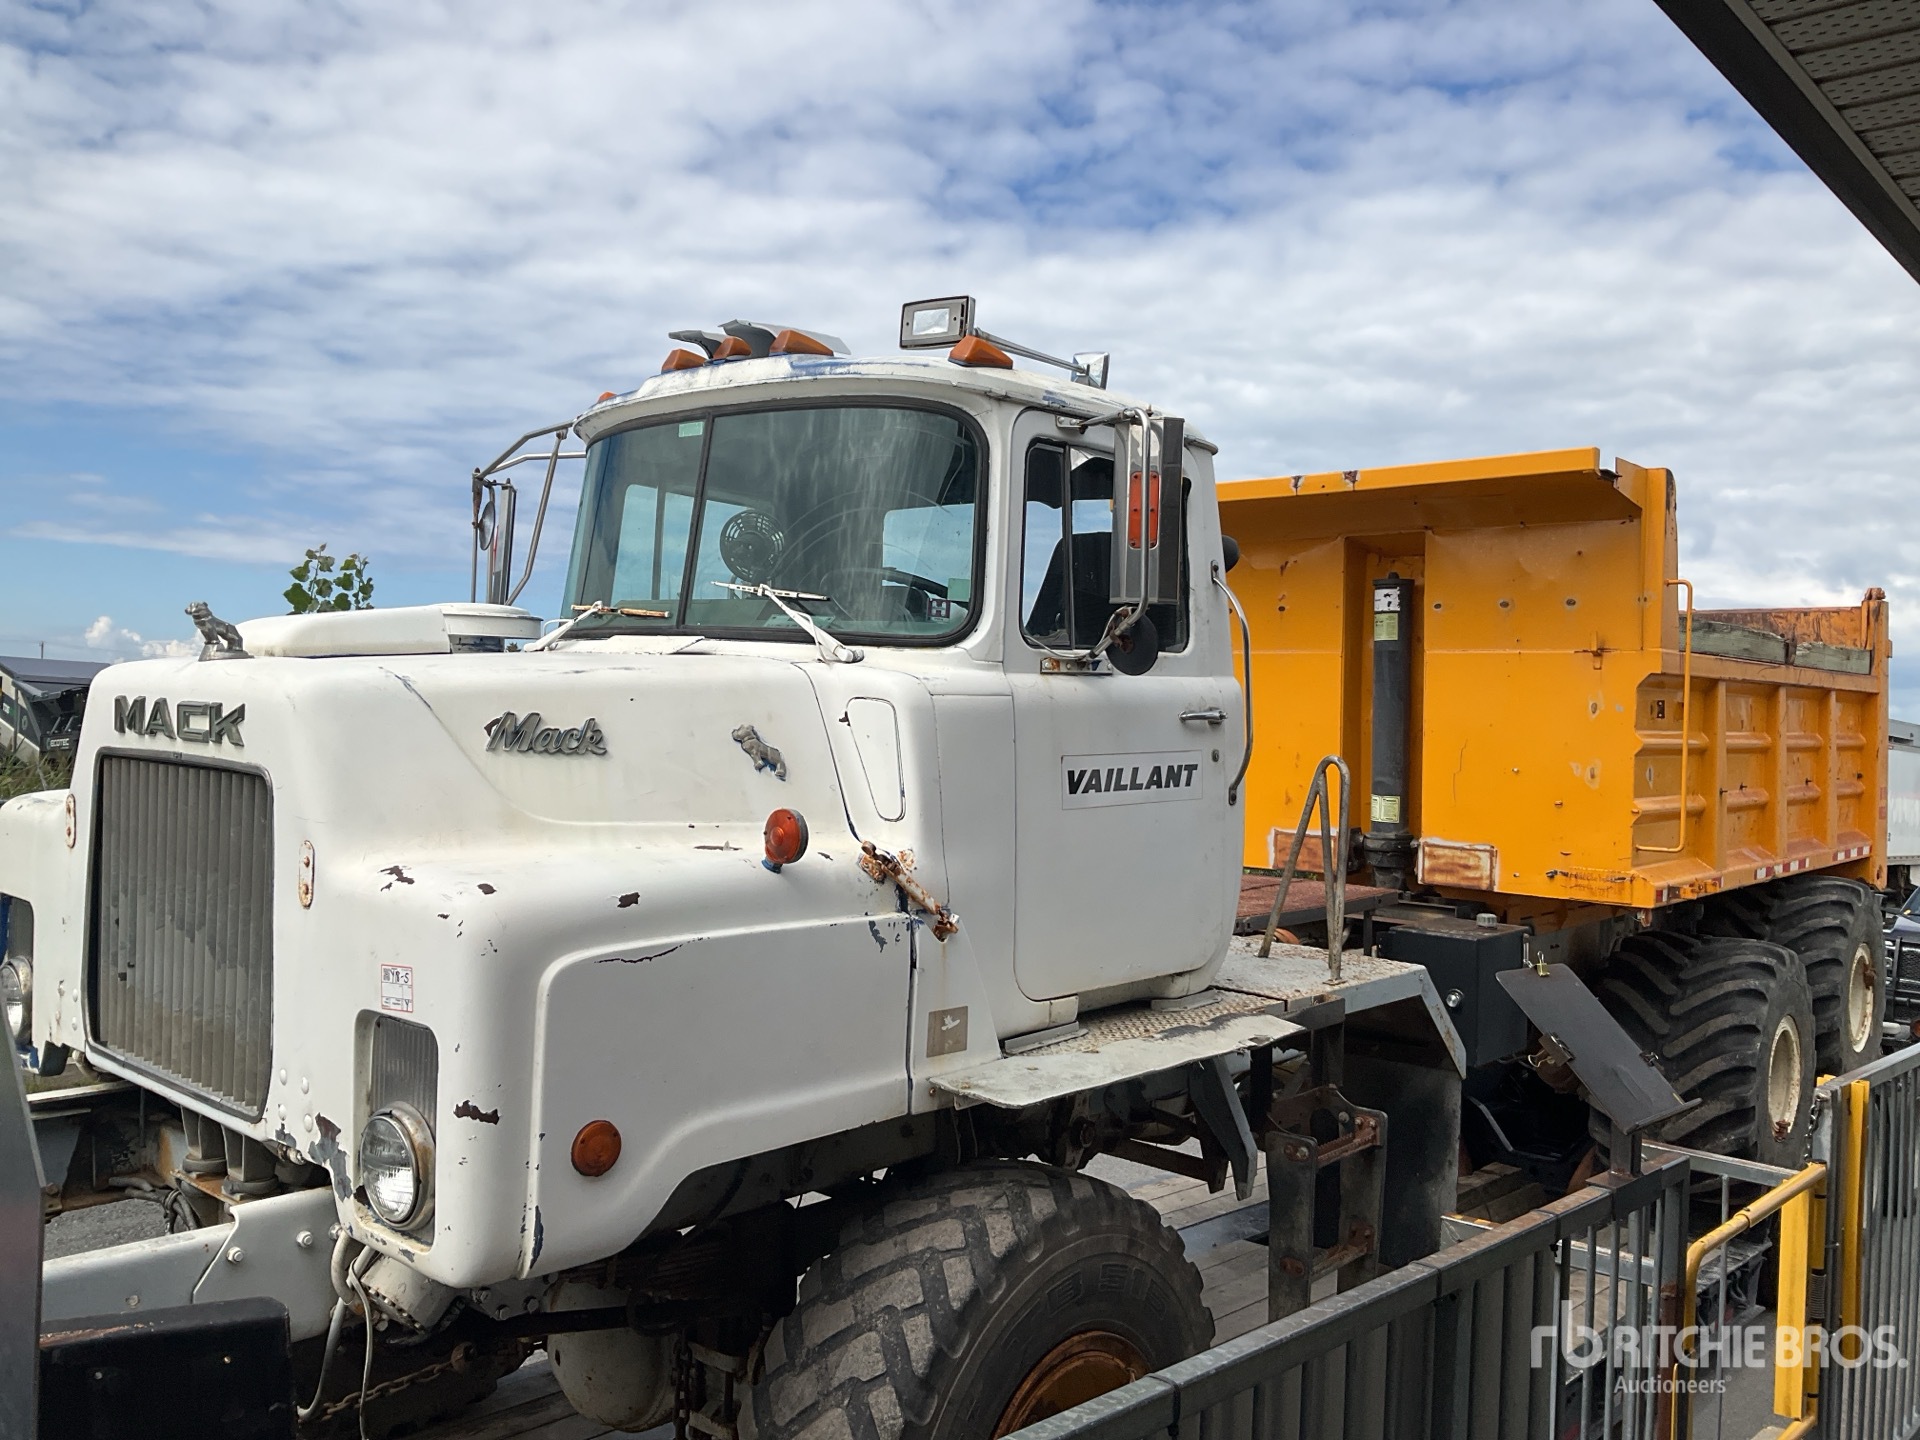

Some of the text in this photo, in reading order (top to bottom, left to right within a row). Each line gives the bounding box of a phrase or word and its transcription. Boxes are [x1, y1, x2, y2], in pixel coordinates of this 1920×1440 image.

[114, 695, 246, 747] MACK
[486, 711, 608, 755] Mack
[1067, 763, 1198, 795] VAILLANT
